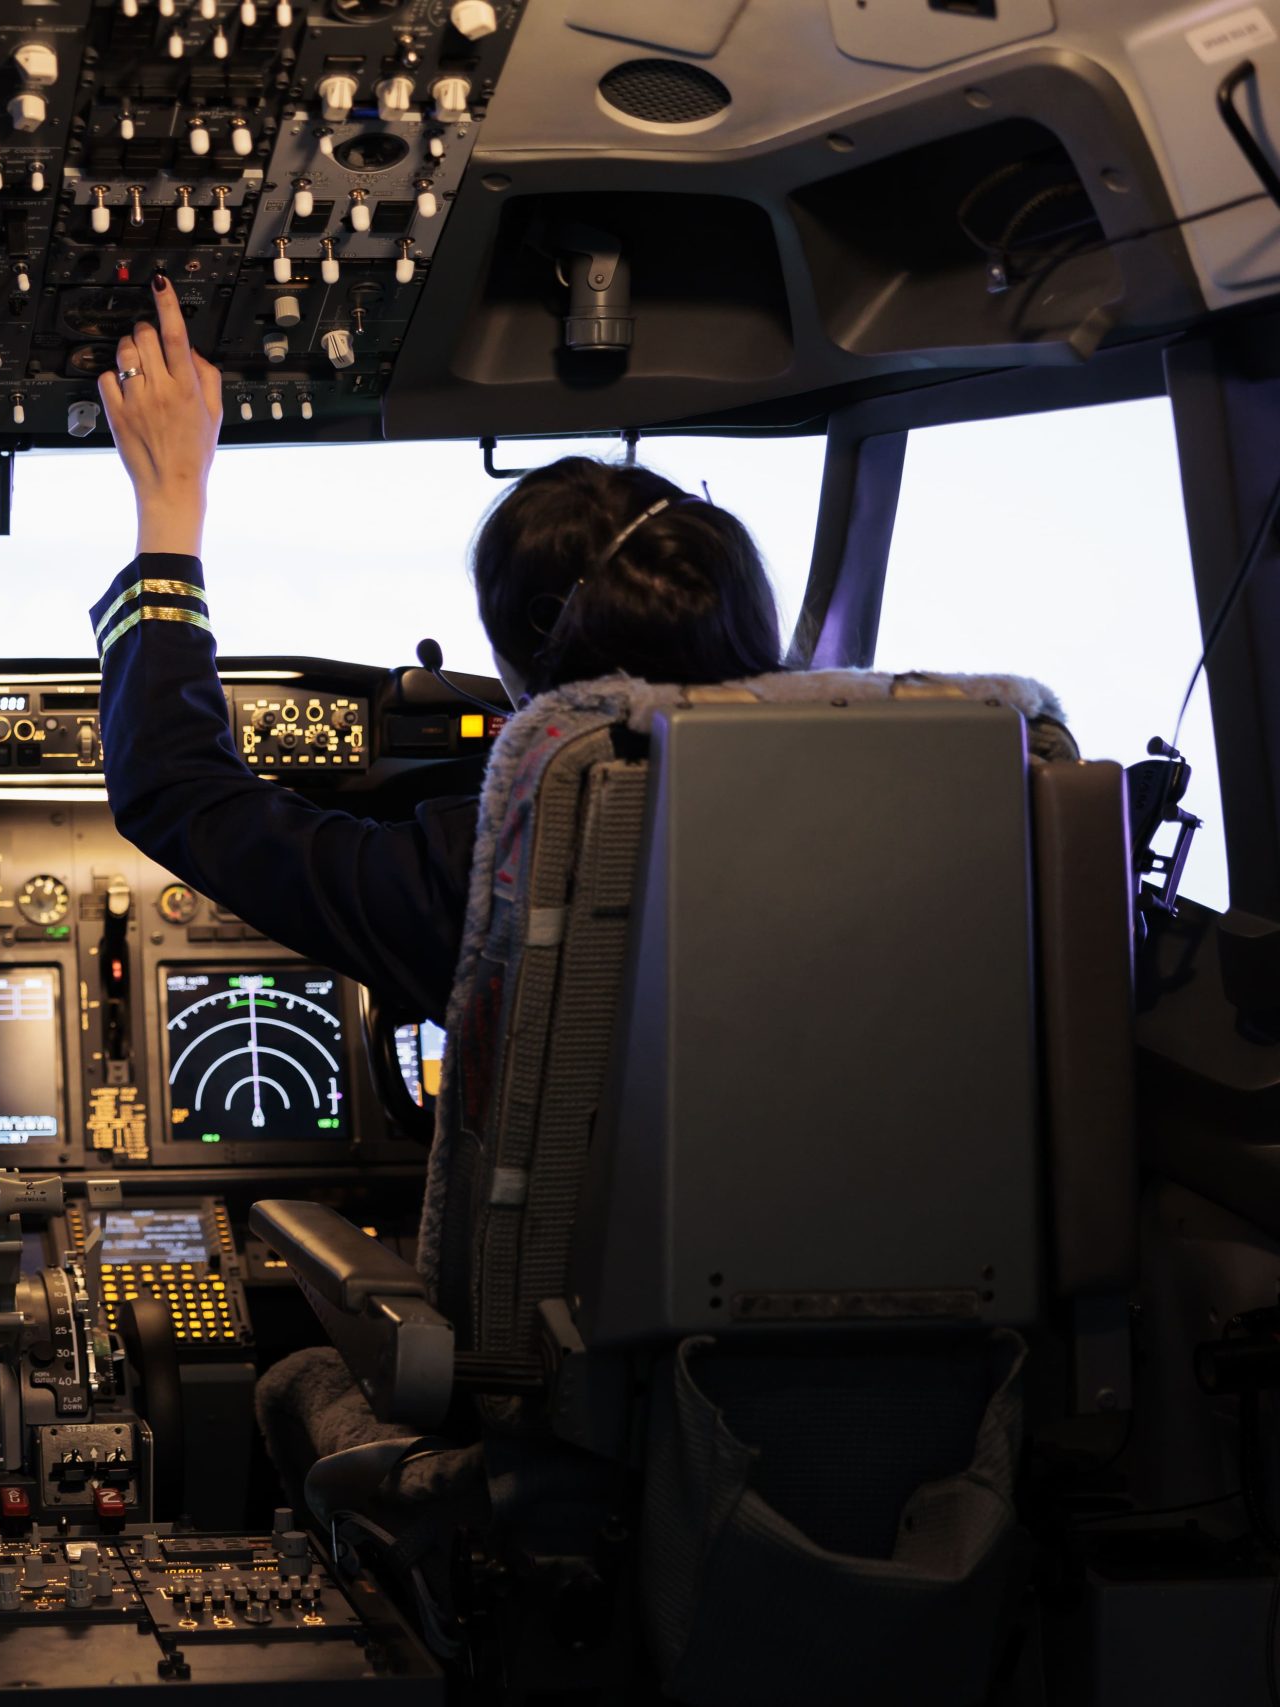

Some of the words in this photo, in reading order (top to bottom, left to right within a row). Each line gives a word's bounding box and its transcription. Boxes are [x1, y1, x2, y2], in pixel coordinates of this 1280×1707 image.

[54, 1326, 68, 1335] 25
[56, 1349, 70, 1358] 30
[58, 1377, 73, 1386] 40
[63, 1396, 82, 1404] FLAP
[62, 1403, 83, 1411] DOWN
[101, 1491, 118, 1504] 2
